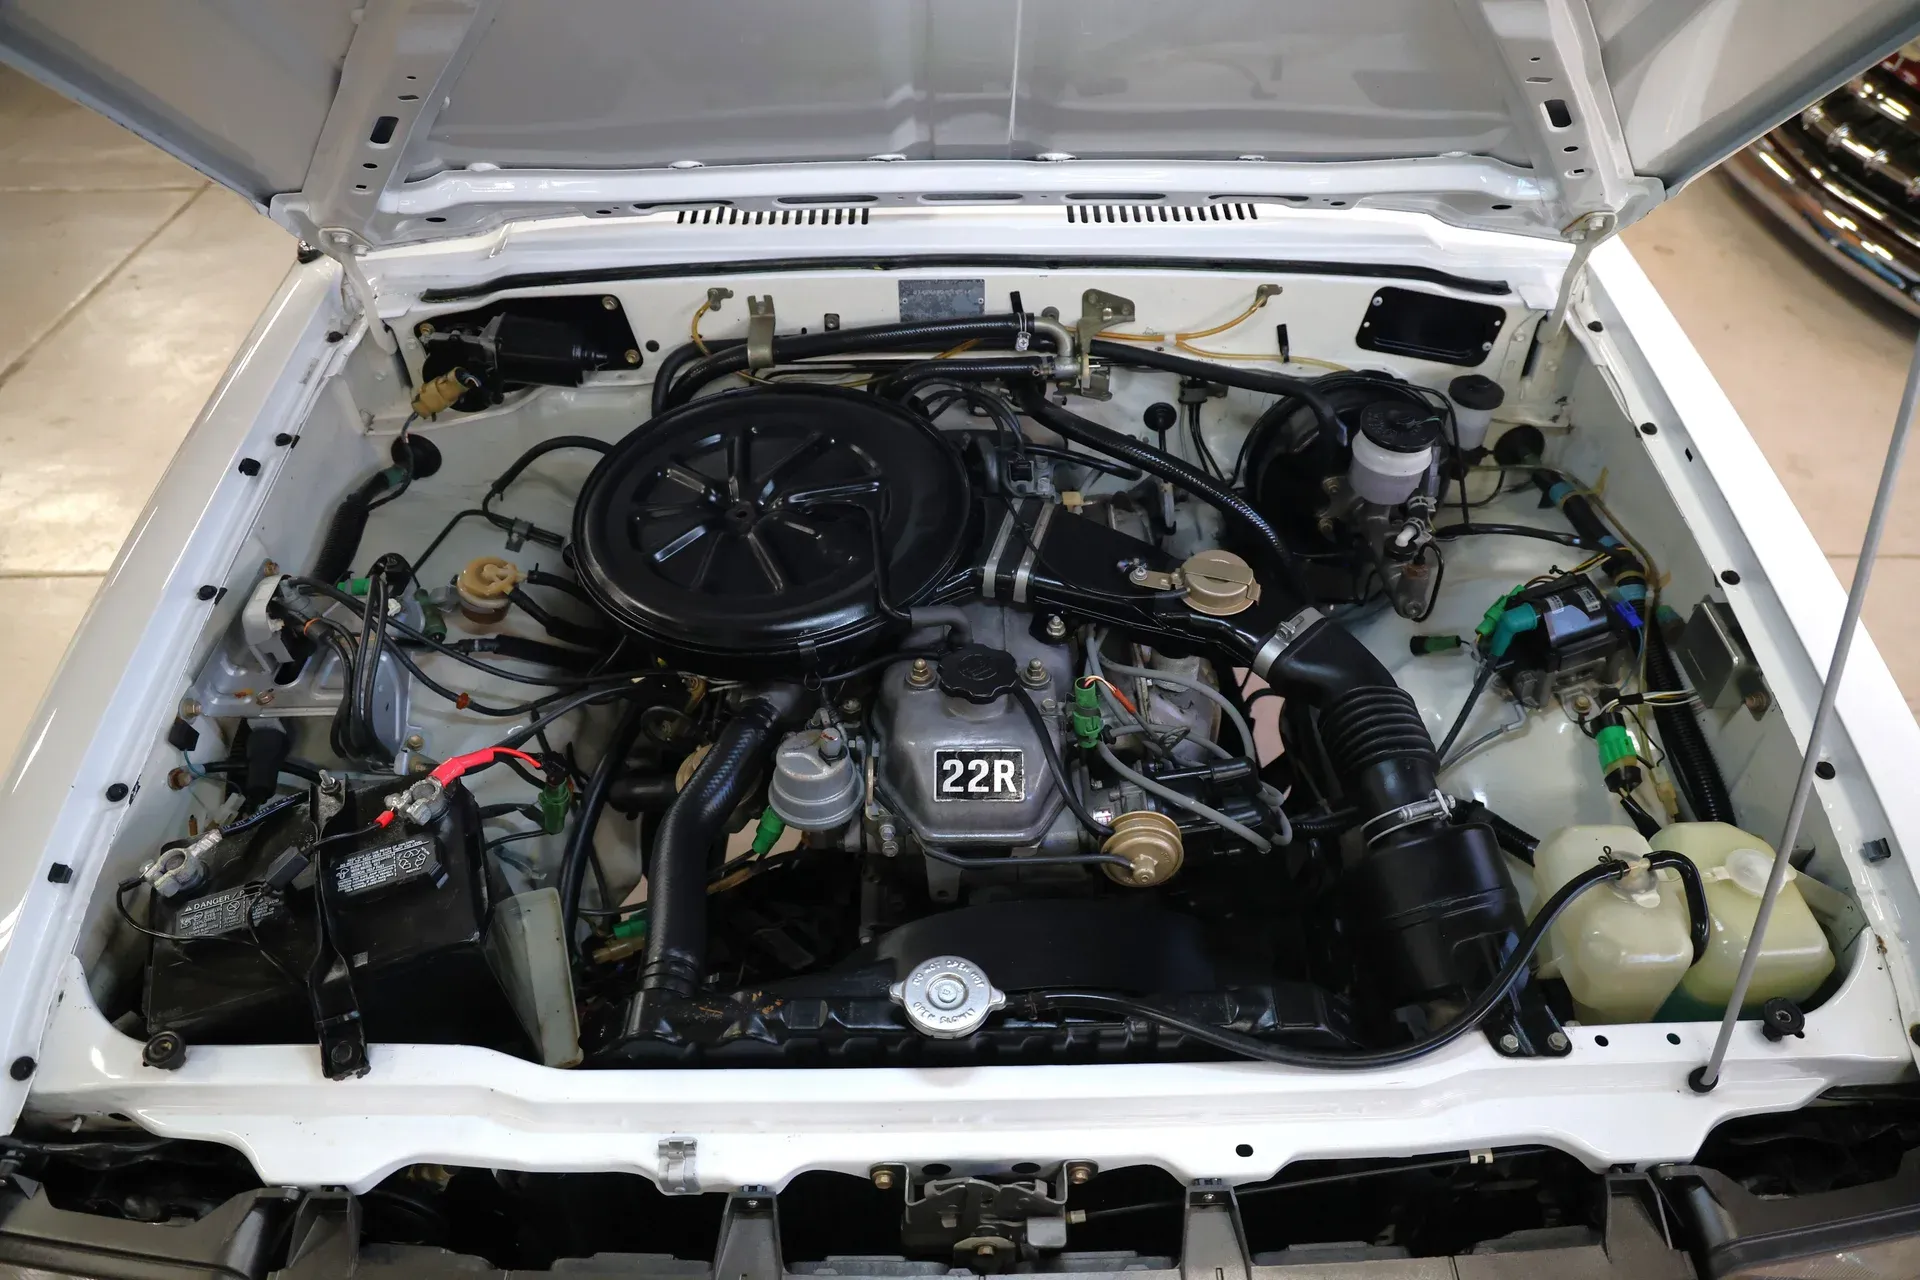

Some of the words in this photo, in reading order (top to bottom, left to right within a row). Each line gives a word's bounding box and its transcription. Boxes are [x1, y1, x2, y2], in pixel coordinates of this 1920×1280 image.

[942, 759, 1017, 793] 22R
[193, 894, 230, 909] DANGER
[912, 972, 924, 986] DO
[925, 961, 941, 974] NOT
[946, 960, 970, 973] OPEN
[912, 1001, 936, 1020] OPEN
